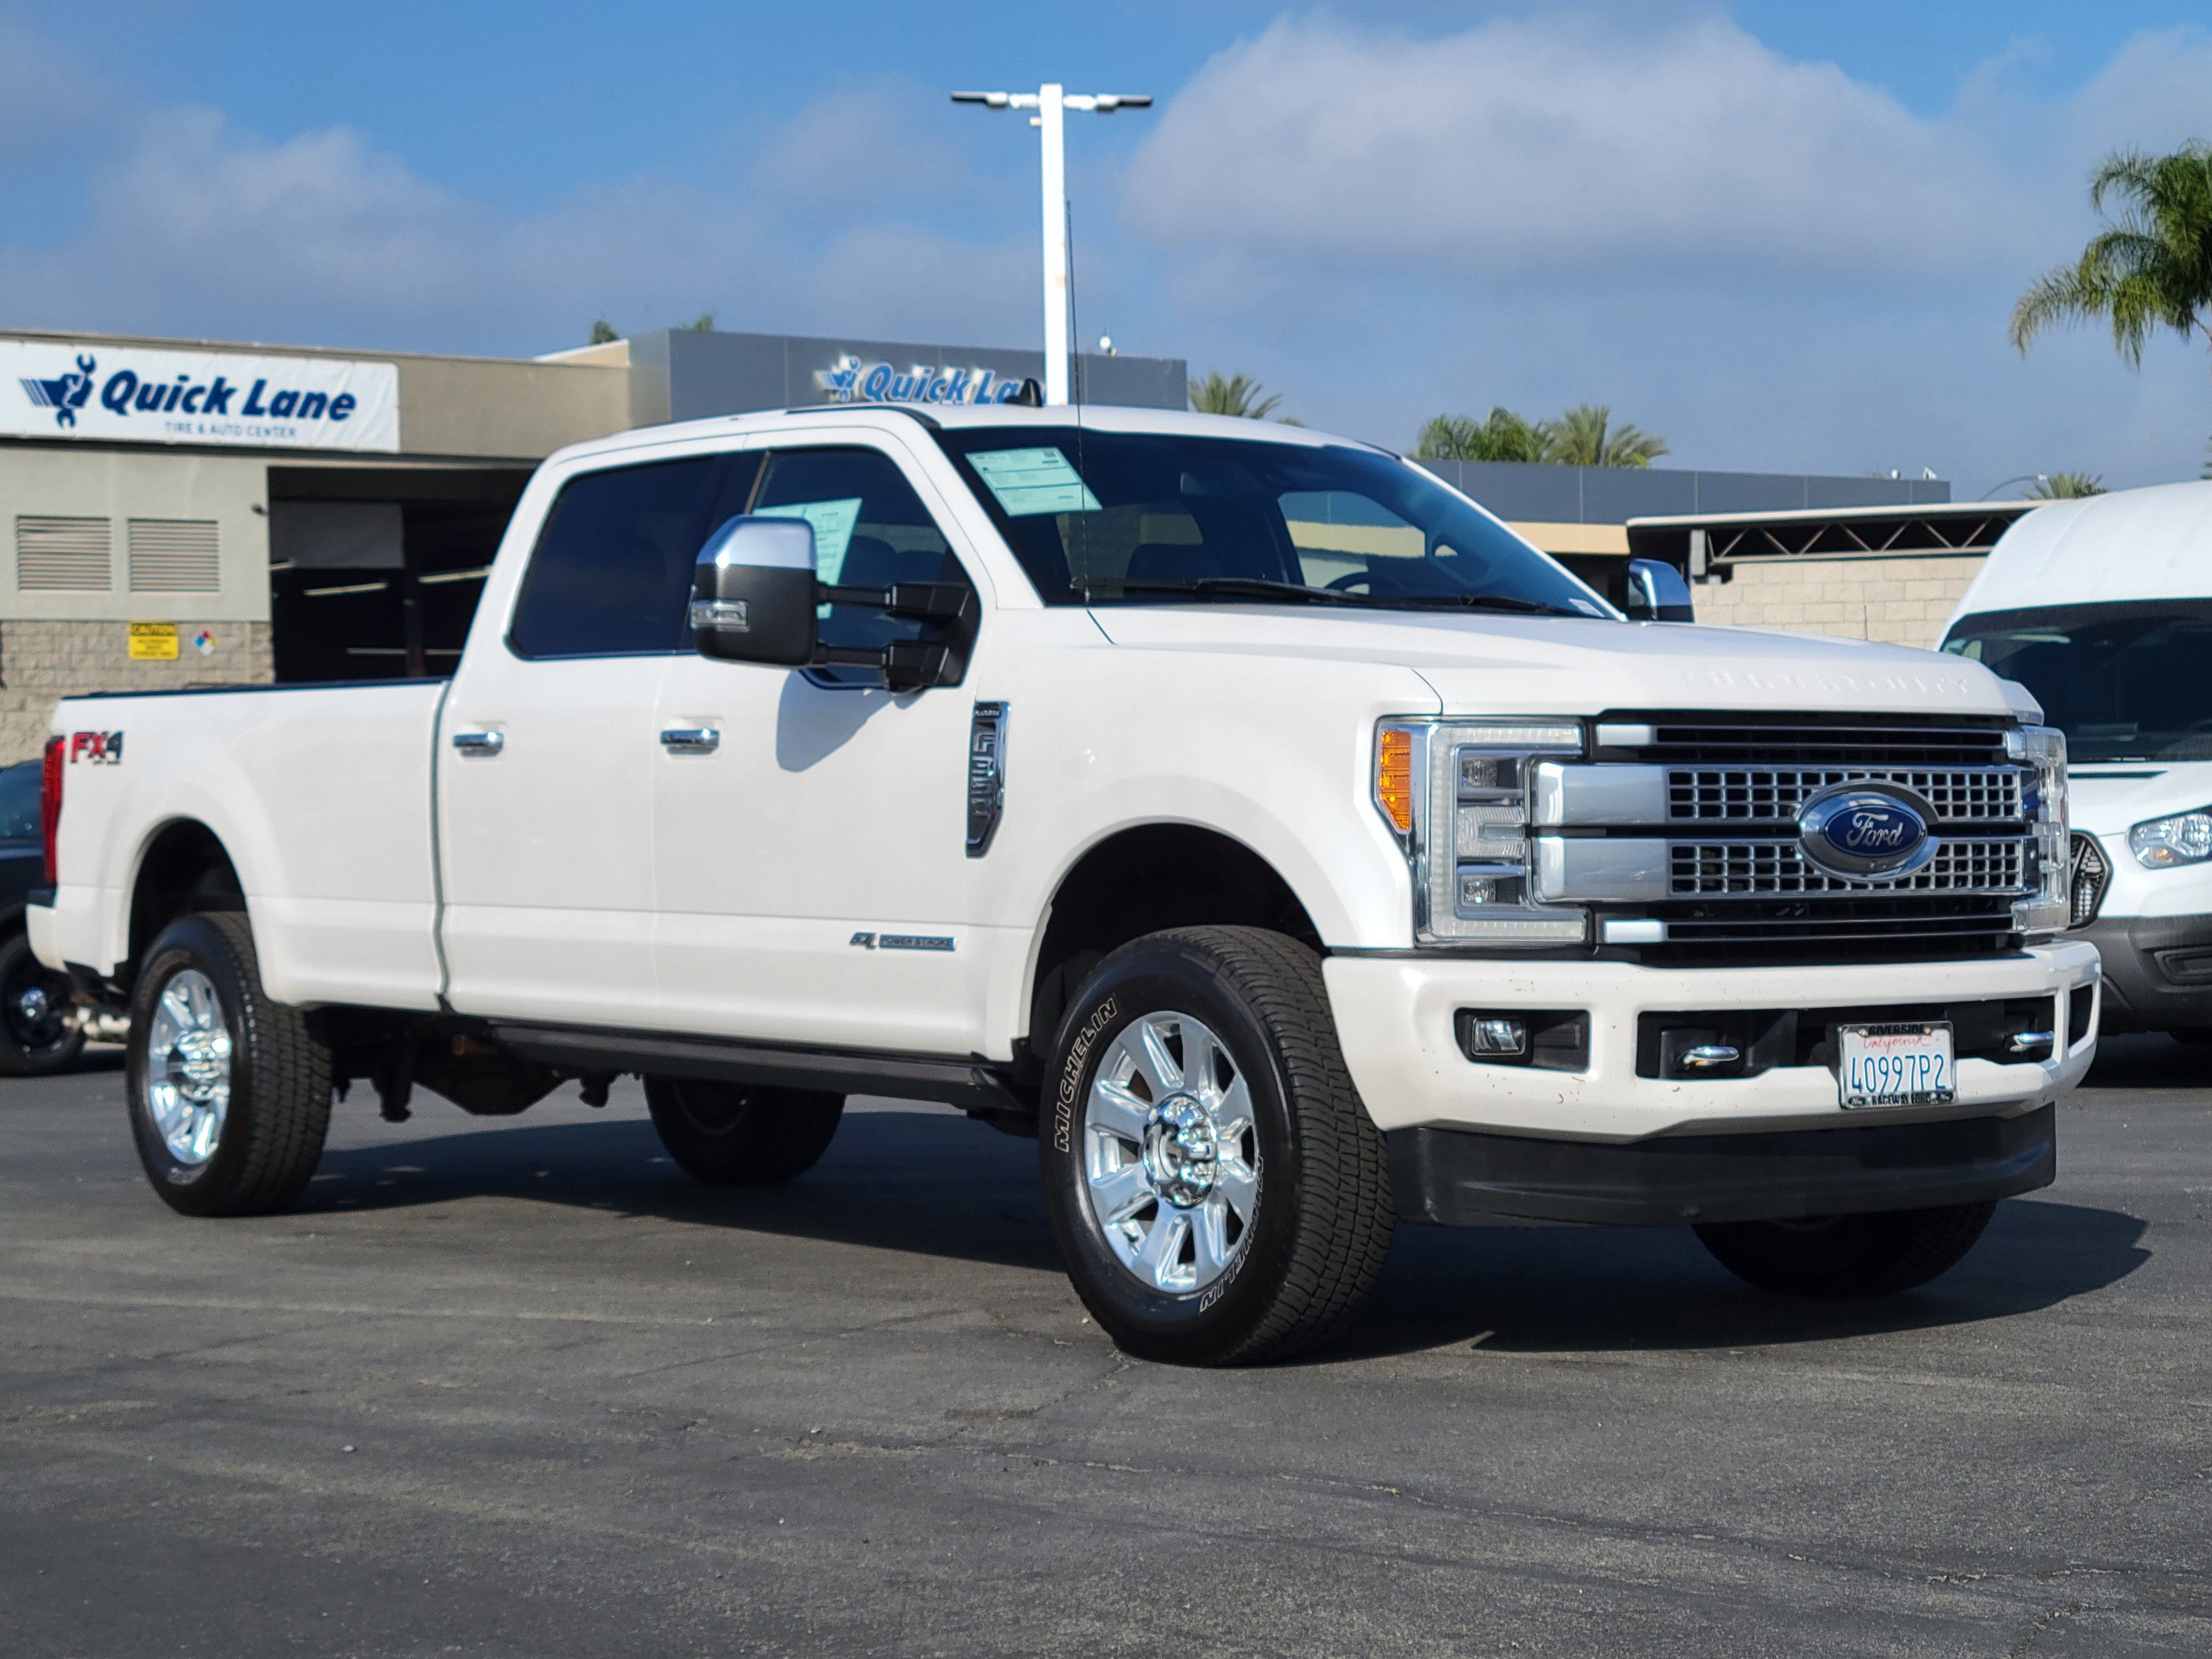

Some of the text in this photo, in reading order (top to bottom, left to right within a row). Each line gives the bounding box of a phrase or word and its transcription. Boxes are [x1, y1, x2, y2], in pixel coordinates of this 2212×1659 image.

[100, 370, 357, 422] Quick Lane
[864, 363, 970, 404] Quick
[165, 421, 296, 438] TIRE & AUTO CENTER
[70, 731, 124, 764] FX4
[1846, 812, 1904, 847] Ford
[1863, 1036, 1931, 1053] California
[1868, 1024, 1925, 1035] RIVERSIDE
[1054, 997, 1118, 1153] MICHELIN
[1851, 1054, 1946, 1093] 40997P2
[1871, 1093, 1909, 1106] RACEWAY
[1911, 1092, 1931, 1104] FORD
